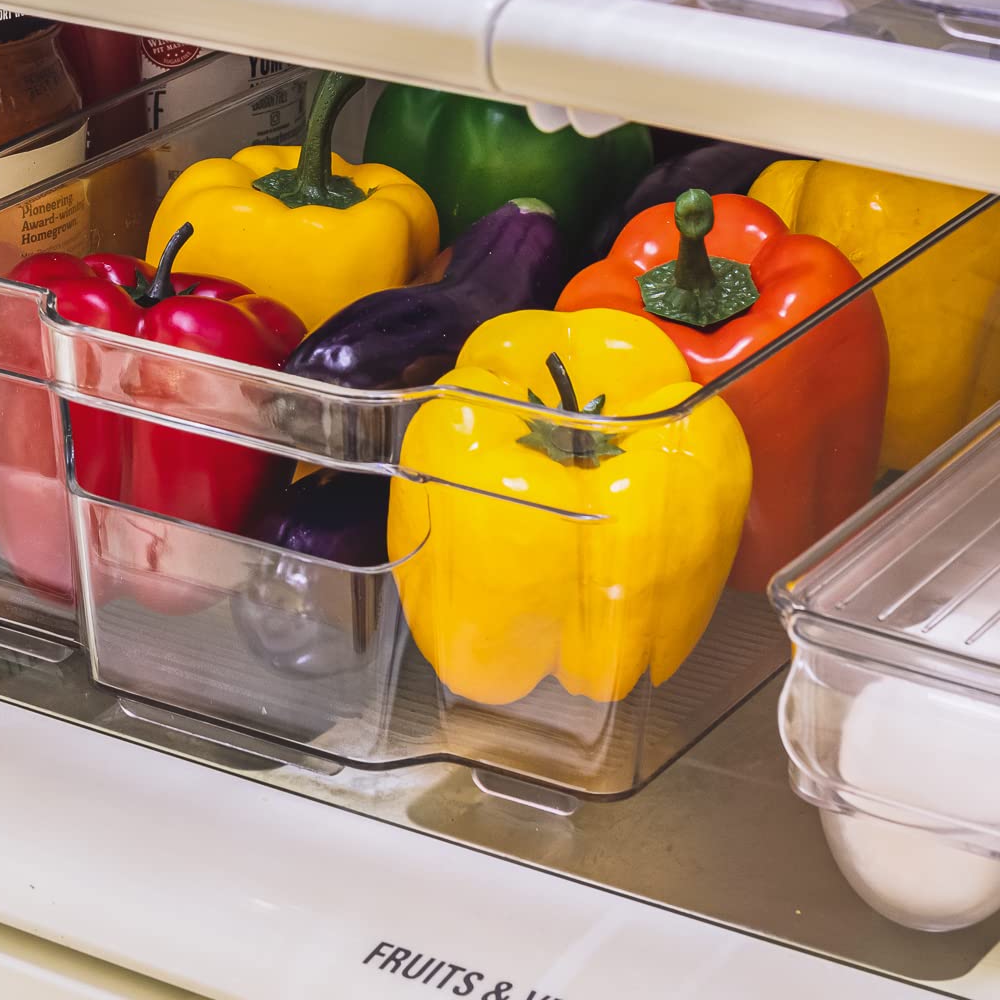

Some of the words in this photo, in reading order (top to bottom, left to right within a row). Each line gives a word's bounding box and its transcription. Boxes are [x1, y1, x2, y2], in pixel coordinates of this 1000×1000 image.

[18, 194, 73, 218] Pioneering
[362, 941, 485, 997] FRUITS
[481, 981, 513, 1000] &
